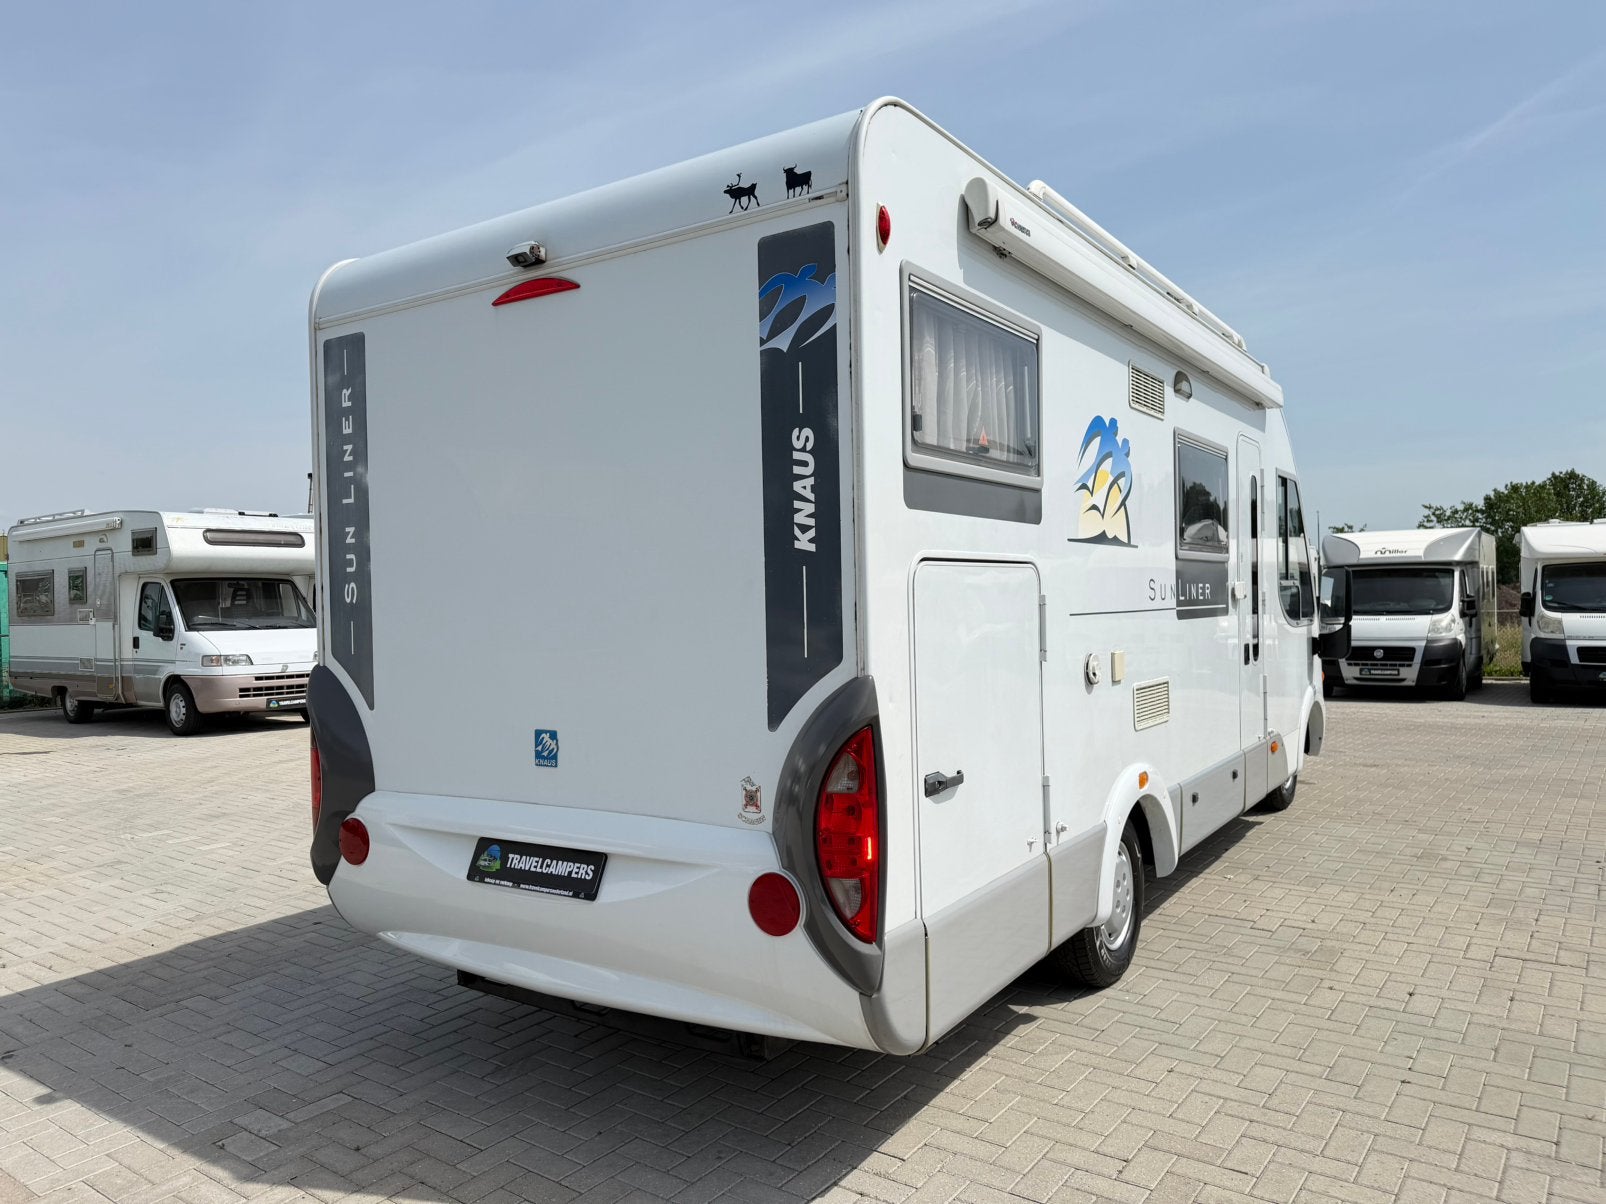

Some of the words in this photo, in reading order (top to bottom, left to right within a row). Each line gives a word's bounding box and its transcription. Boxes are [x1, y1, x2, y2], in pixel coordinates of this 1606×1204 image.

[342, 387, 354, 504] LINER
[791, 427, 816, 552] KNAUS
[344, 527, 357, 604] SUN
[535, 758, 556, 767] KNAUS
[506, 853, 595, 880] TRAVELCAMPERS
